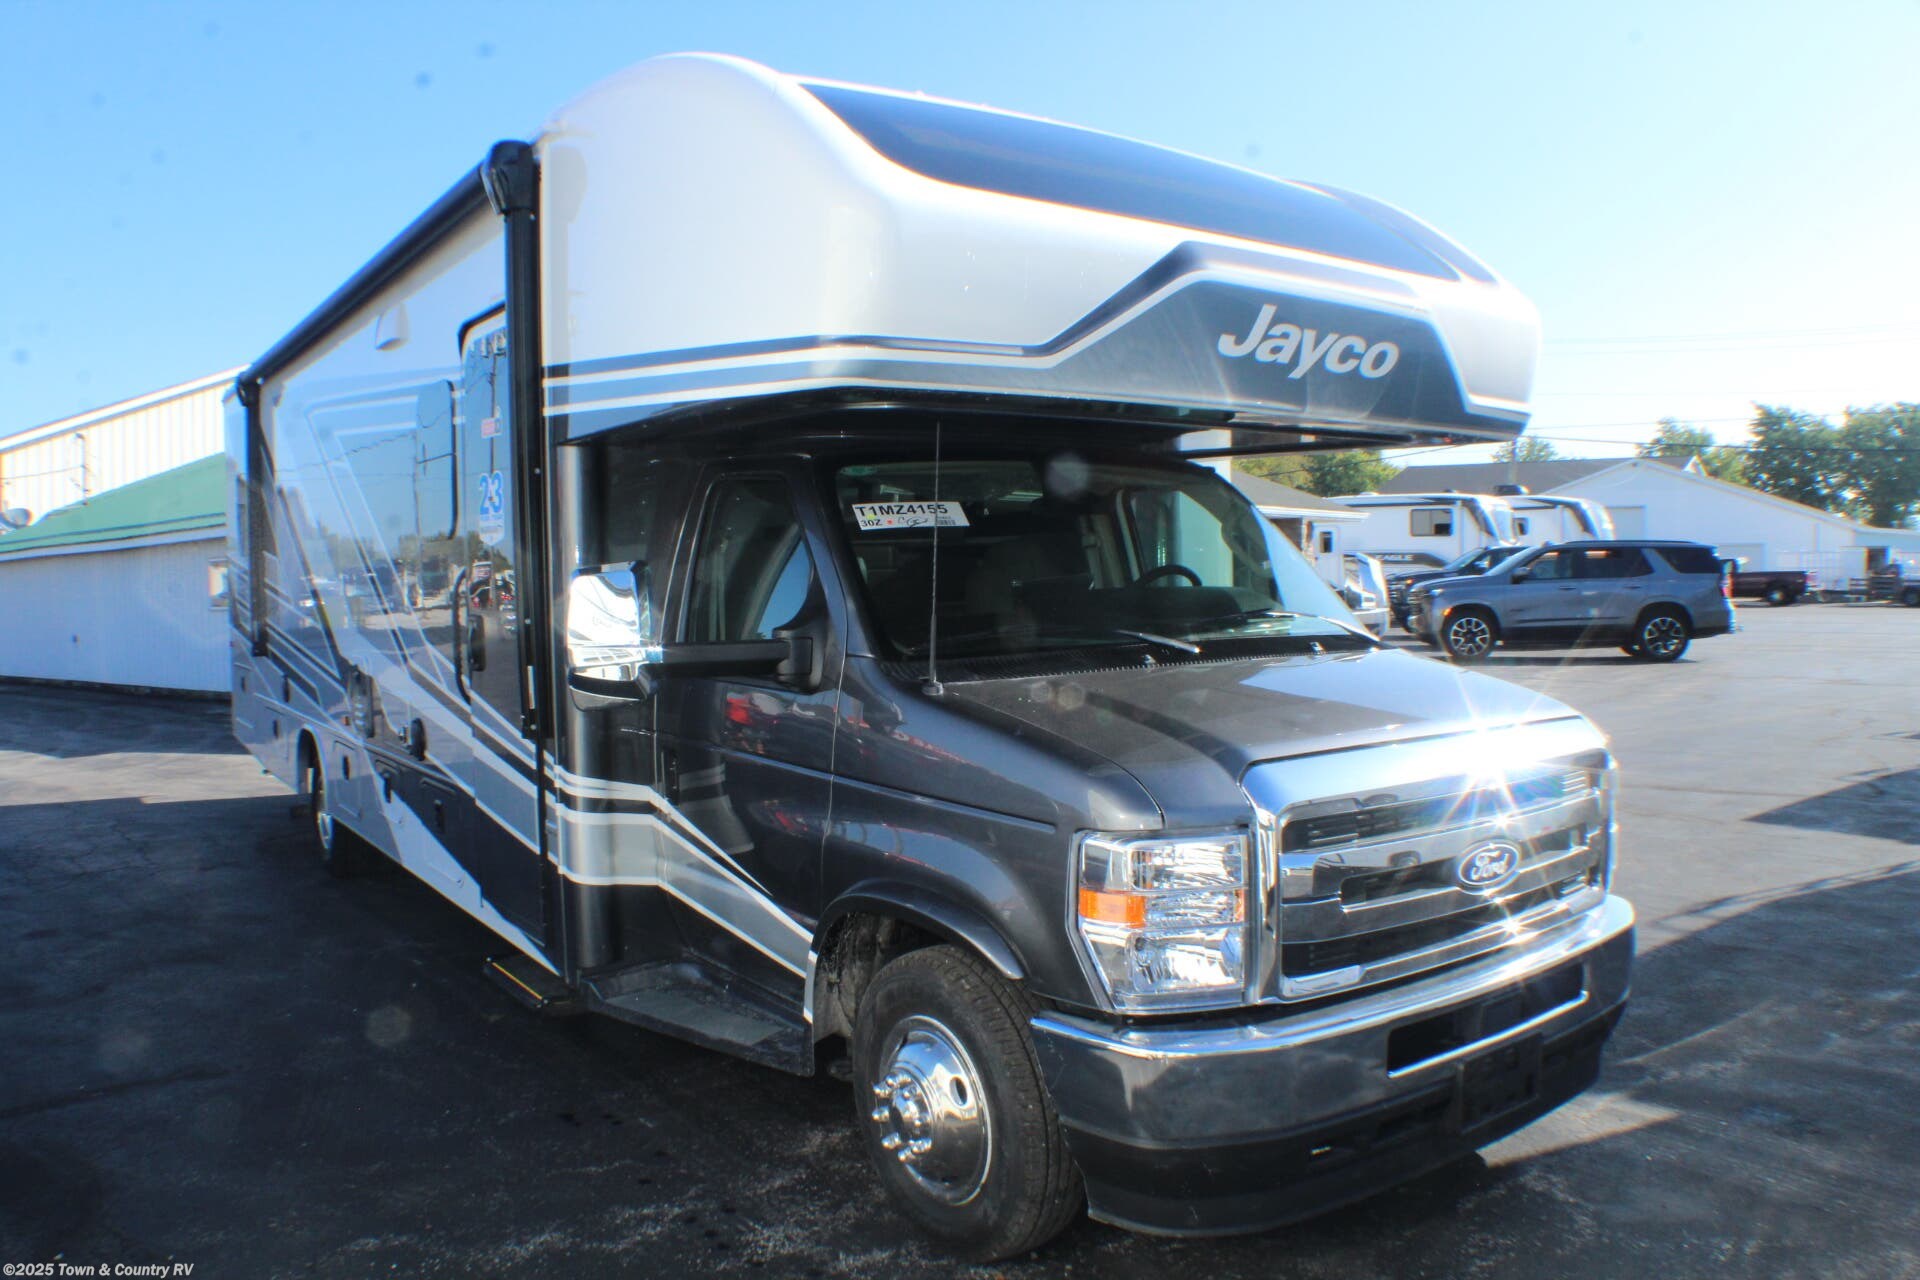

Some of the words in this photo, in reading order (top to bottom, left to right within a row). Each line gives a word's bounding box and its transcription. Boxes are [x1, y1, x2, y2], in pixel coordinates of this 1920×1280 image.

[1218, 303, 1400, 379] Jayco
[855, 504, 948, 517] T1MZ4155
[1471, 850, 1510, 880] Ford
